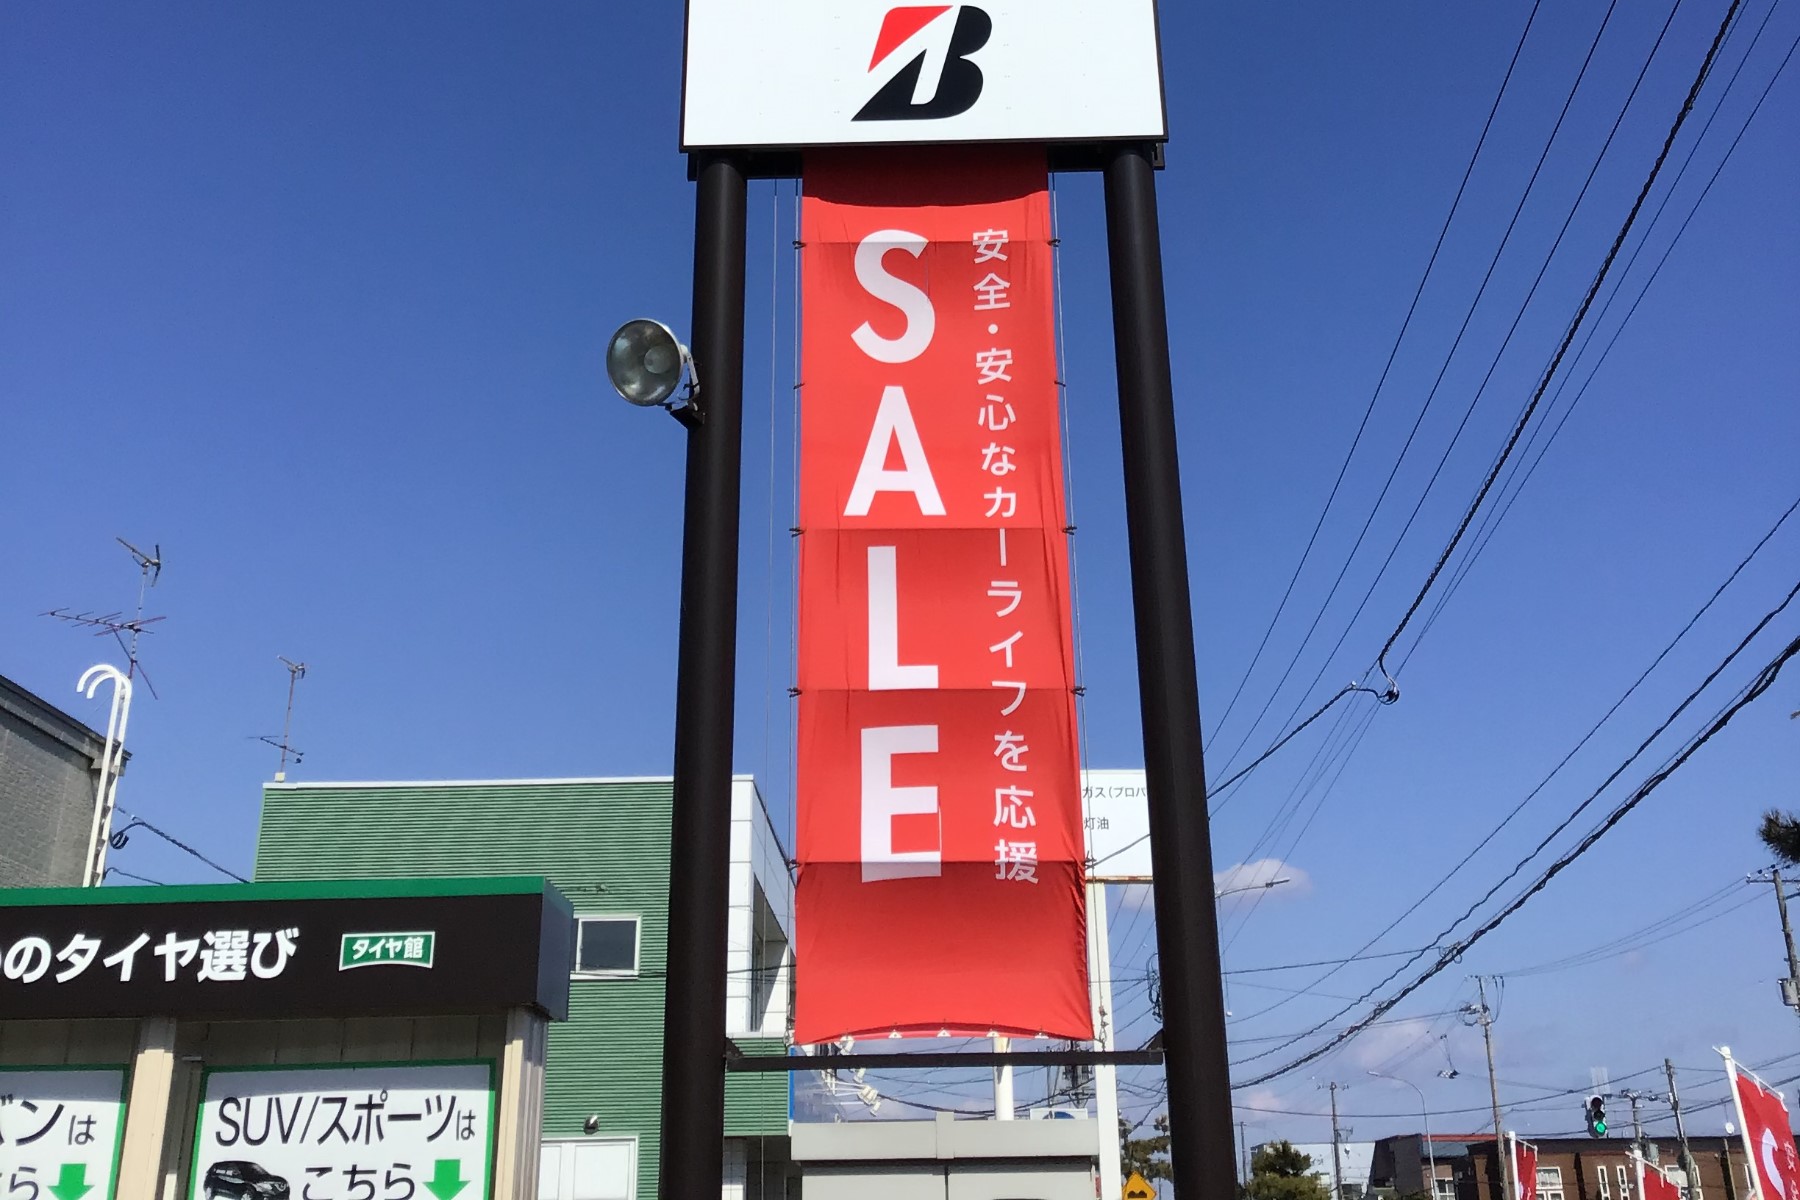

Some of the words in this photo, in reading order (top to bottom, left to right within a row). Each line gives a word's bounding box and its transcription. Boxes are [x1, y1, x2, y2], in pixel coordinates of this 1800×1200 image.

[843, 228, 948, 884] SALE
[971, 228, 1040, 885] 安全・安心なカーライフを応援
[1083, 816, 1110, 831] 灯油
[0, 927, 300, 984] のタイヤ選び
[352, 936, 424, 961] タイヤ館
[0, 1093, 97, 1147] ンは
[215, 1089, 477, 1147] SUV/スポーツは
[302, 1162, 416, 1200] こちら
